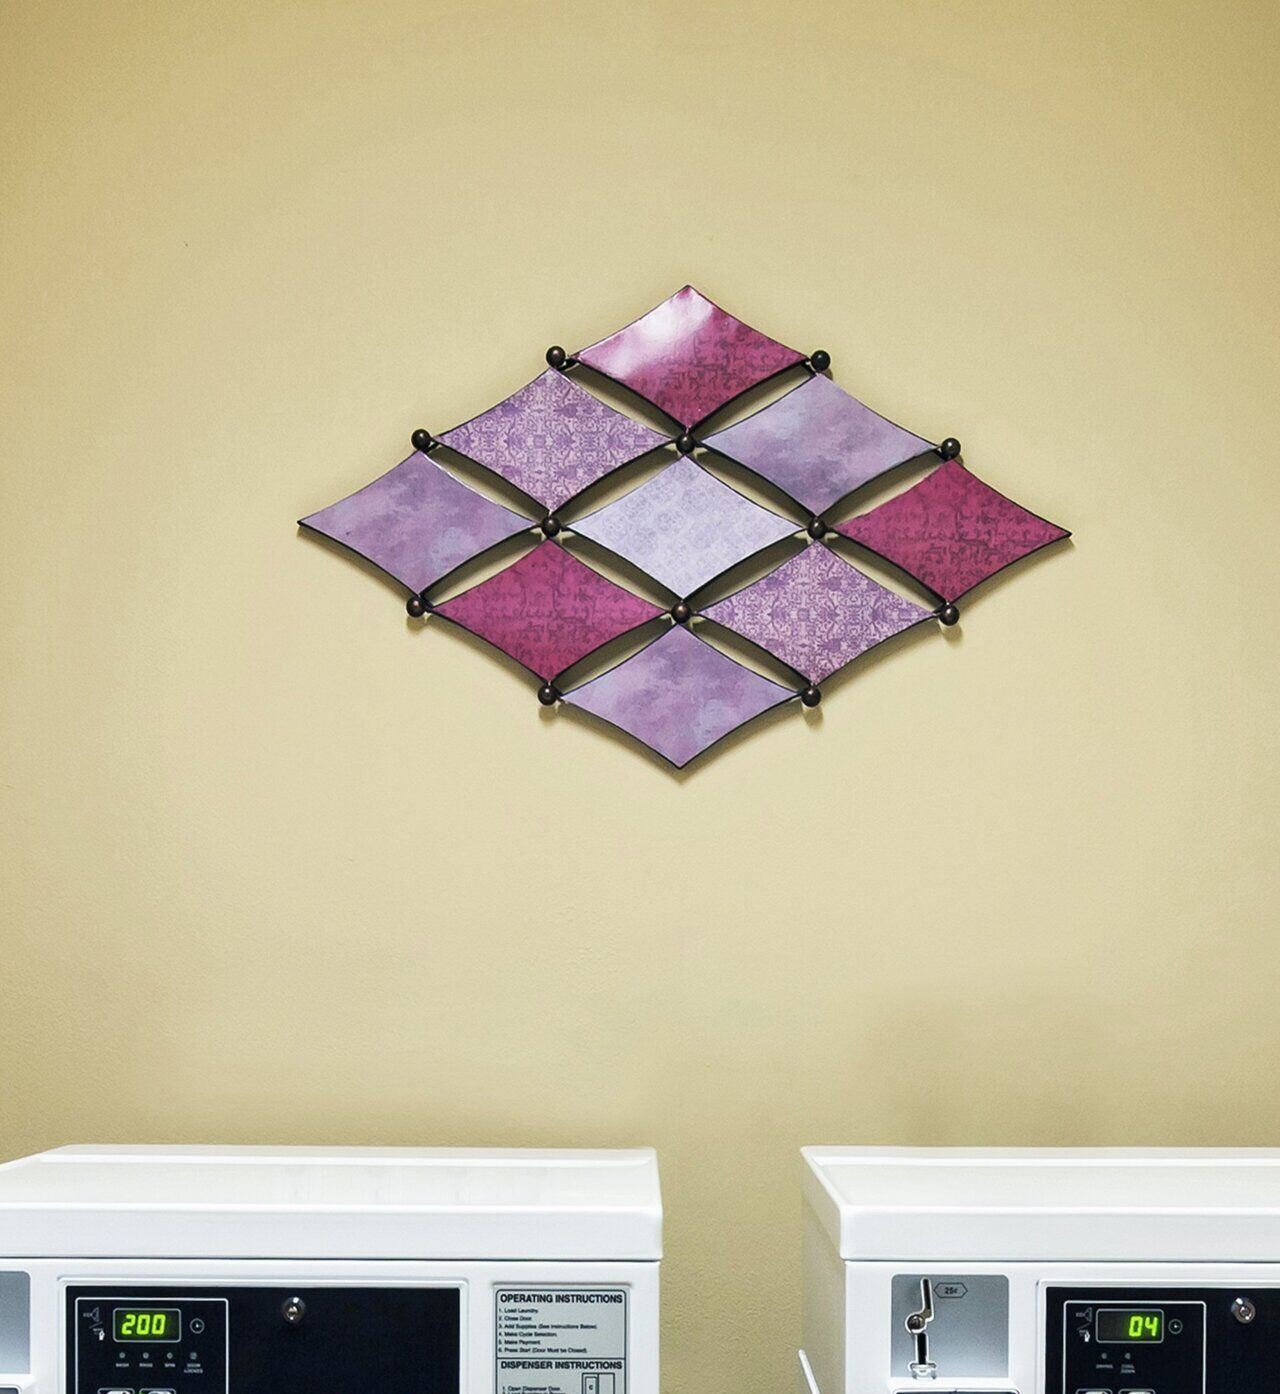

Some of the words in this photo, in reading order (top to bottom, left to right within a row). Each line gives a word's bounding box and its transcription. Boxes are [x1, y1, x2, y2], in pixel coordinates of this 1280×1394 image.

[500, 1294, 553, 1303] OPERATING
[555, 1294, 623, 1303] INSTRUCTIONS
[121, 1314, 166, 1335] 200
[1129, 1316, 1158, 1337] 04
[501, 1361, 553, 1369] DISPENSER
[555, 1361, 623, 1369] INSTRUCTIONS
